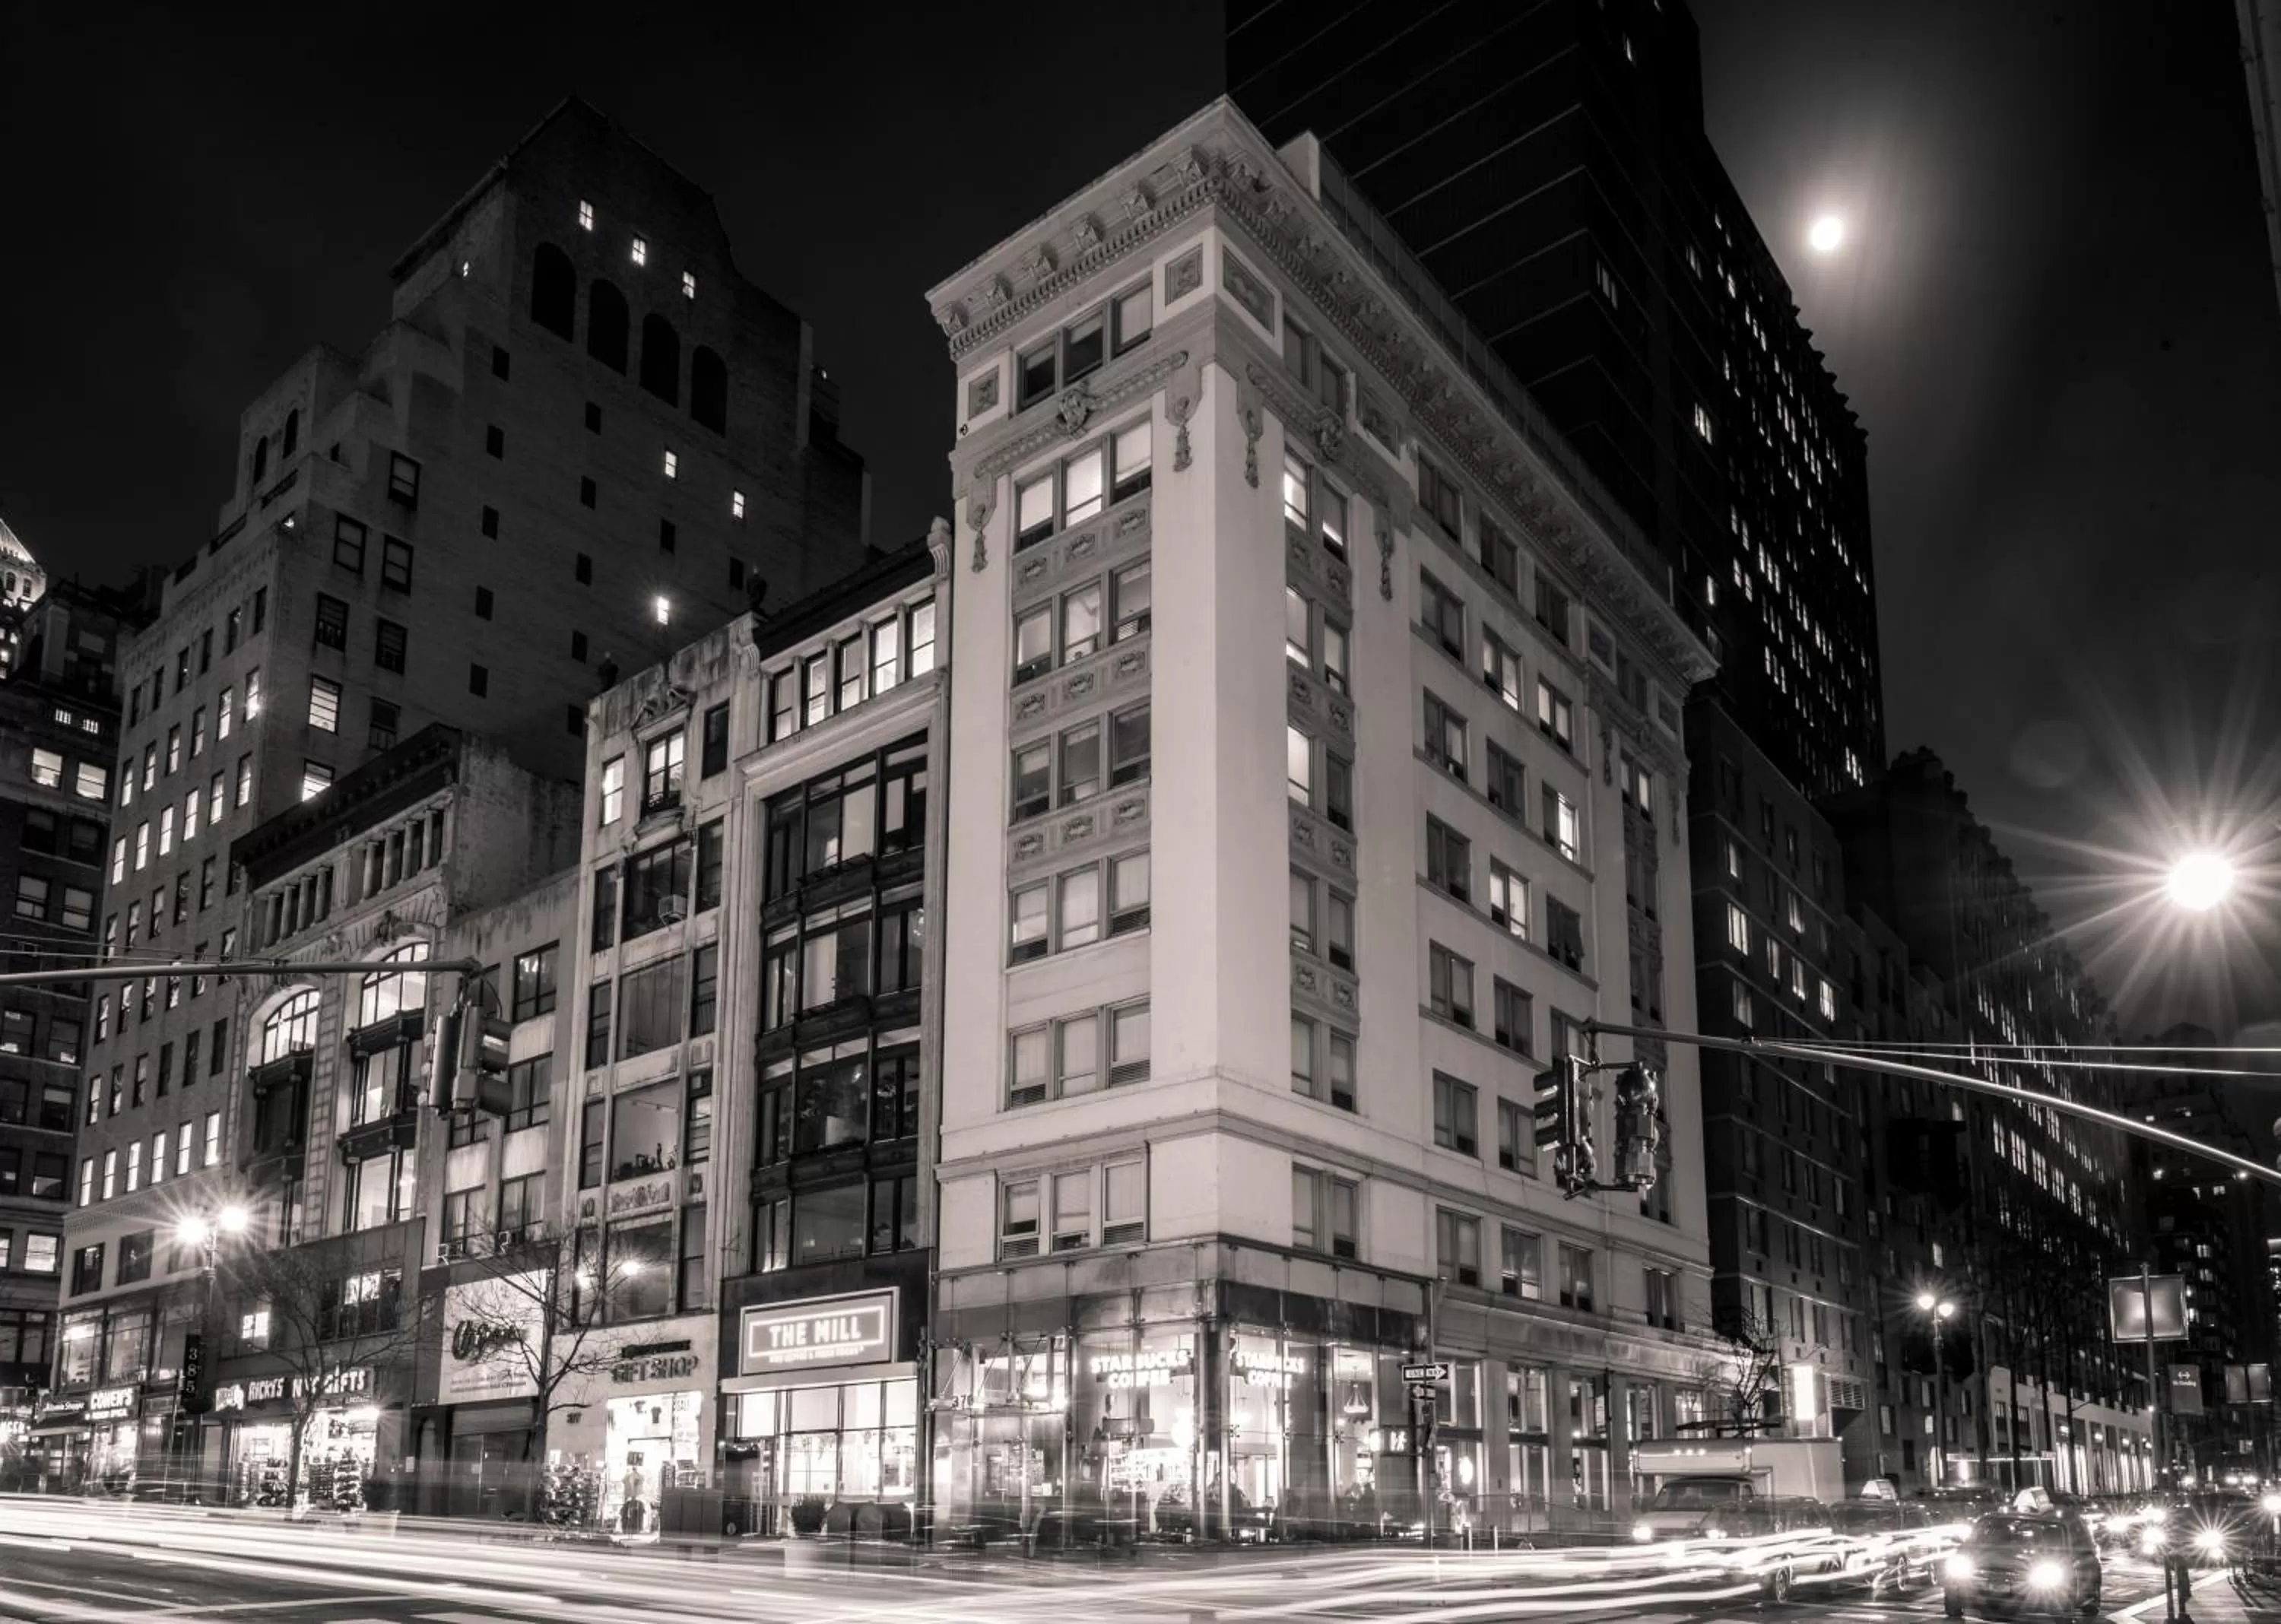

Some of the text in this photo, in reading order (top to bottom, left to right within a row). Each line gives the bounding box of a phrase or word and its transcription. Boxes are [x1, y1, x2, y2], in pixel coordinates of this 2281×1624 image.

[769, 1315, 861, 1348] THE MILL
[649, 1356, 699, 1378] SHOP
[1090, 1350, 1189, 1374] STARBUCKS
